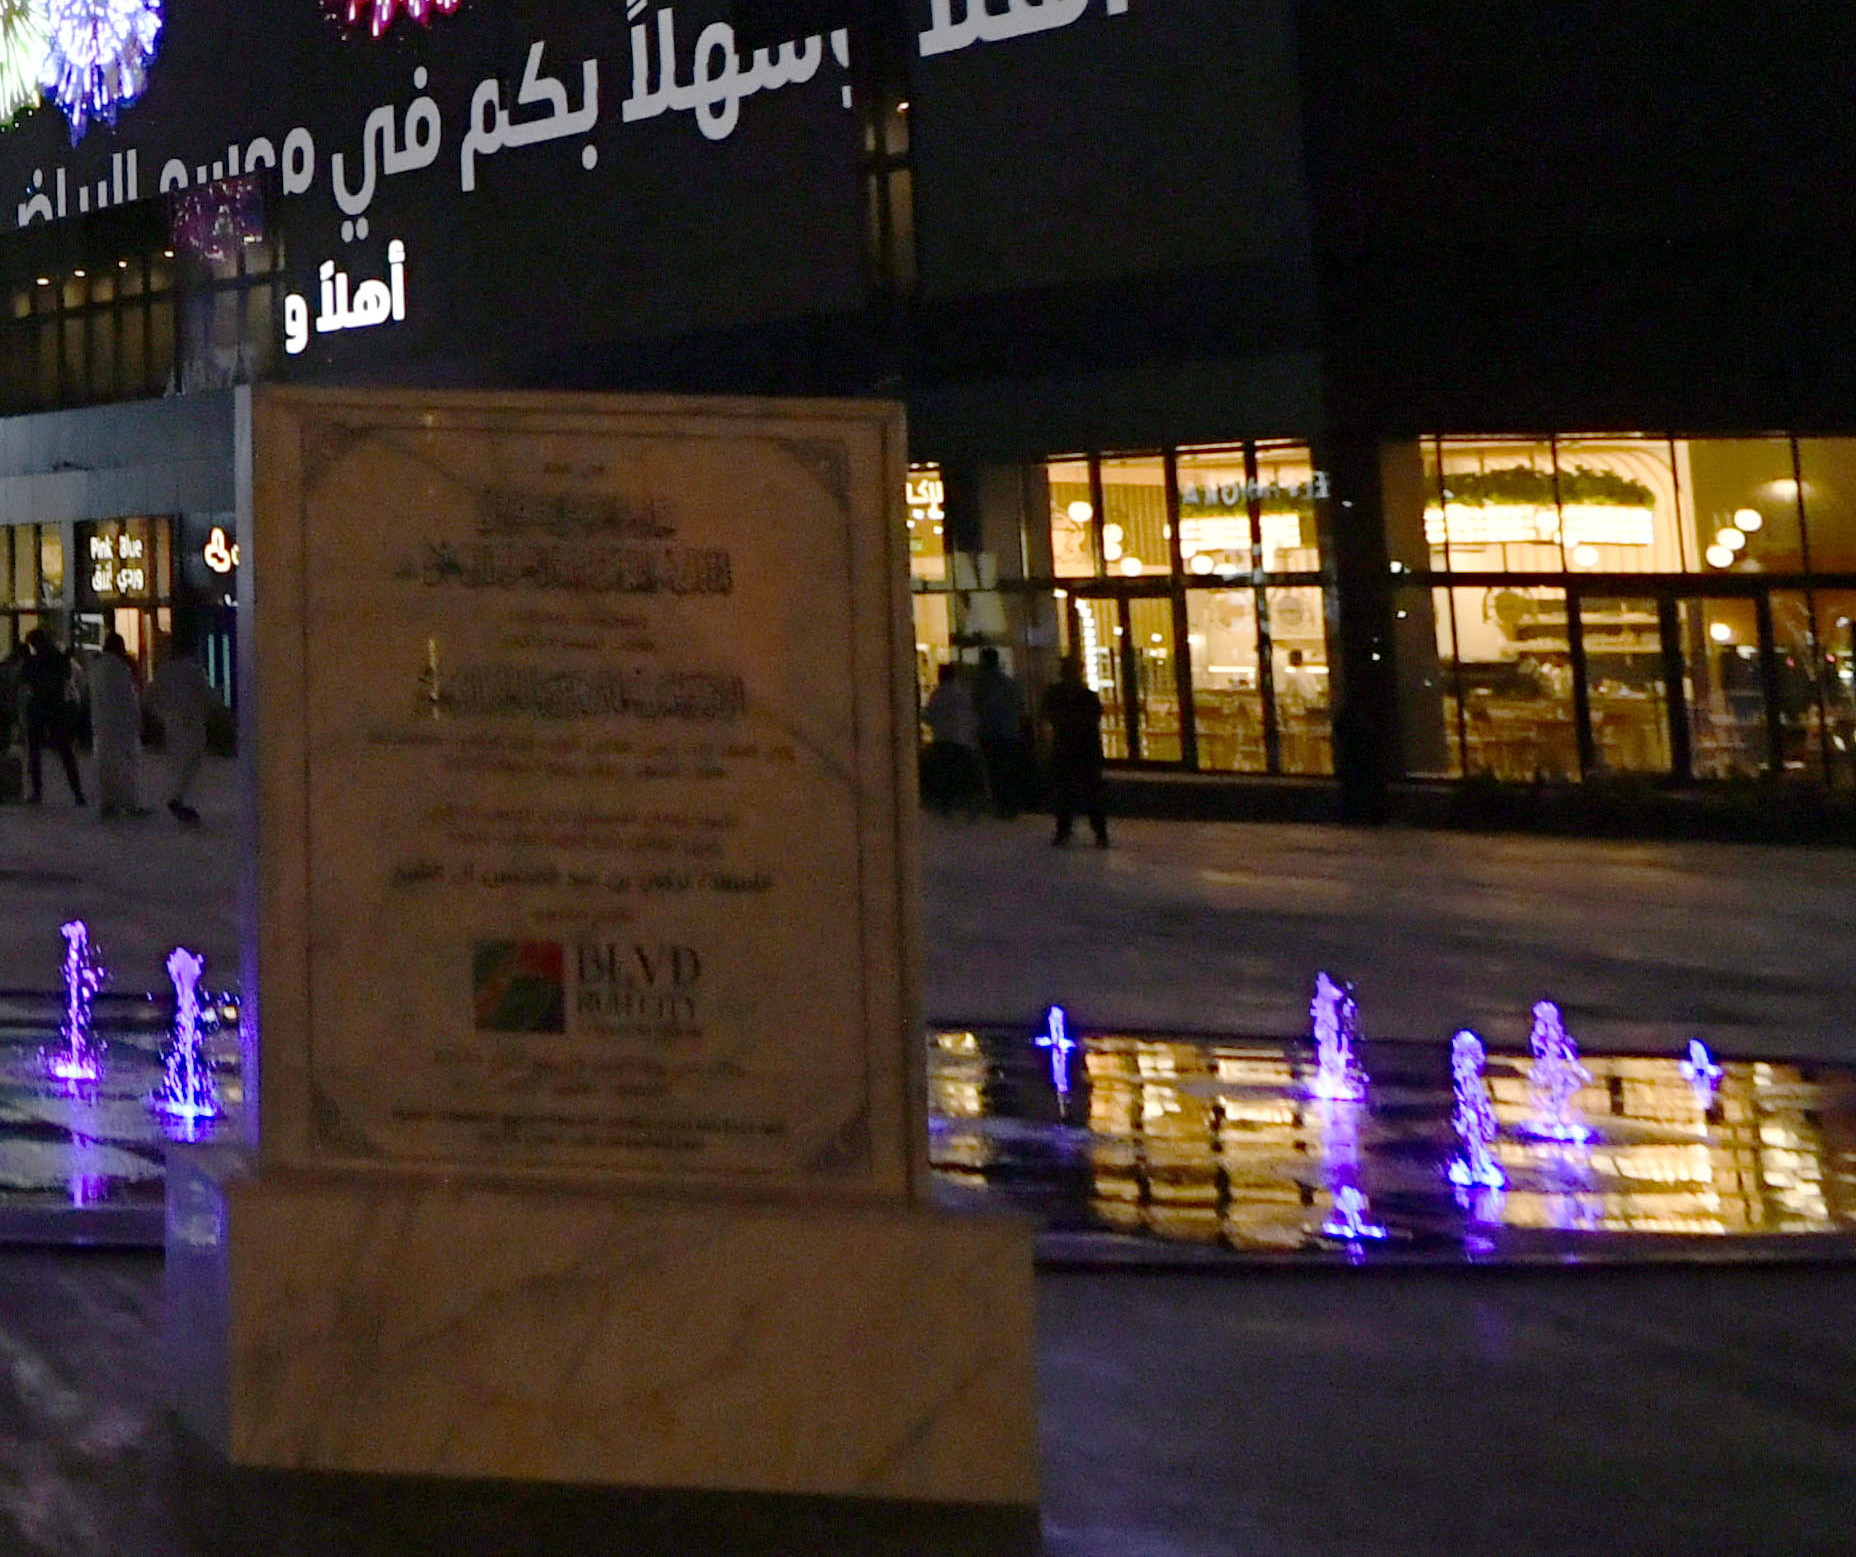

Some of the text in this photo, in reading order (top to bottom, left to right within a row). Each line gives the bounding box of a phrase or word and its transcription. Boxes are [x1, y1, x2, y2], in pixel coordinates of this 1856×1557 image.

[332, 66, 441, 242] في
[461, 39, 598, 191] بكم
[316, 240, 406, 333] أهلاً
